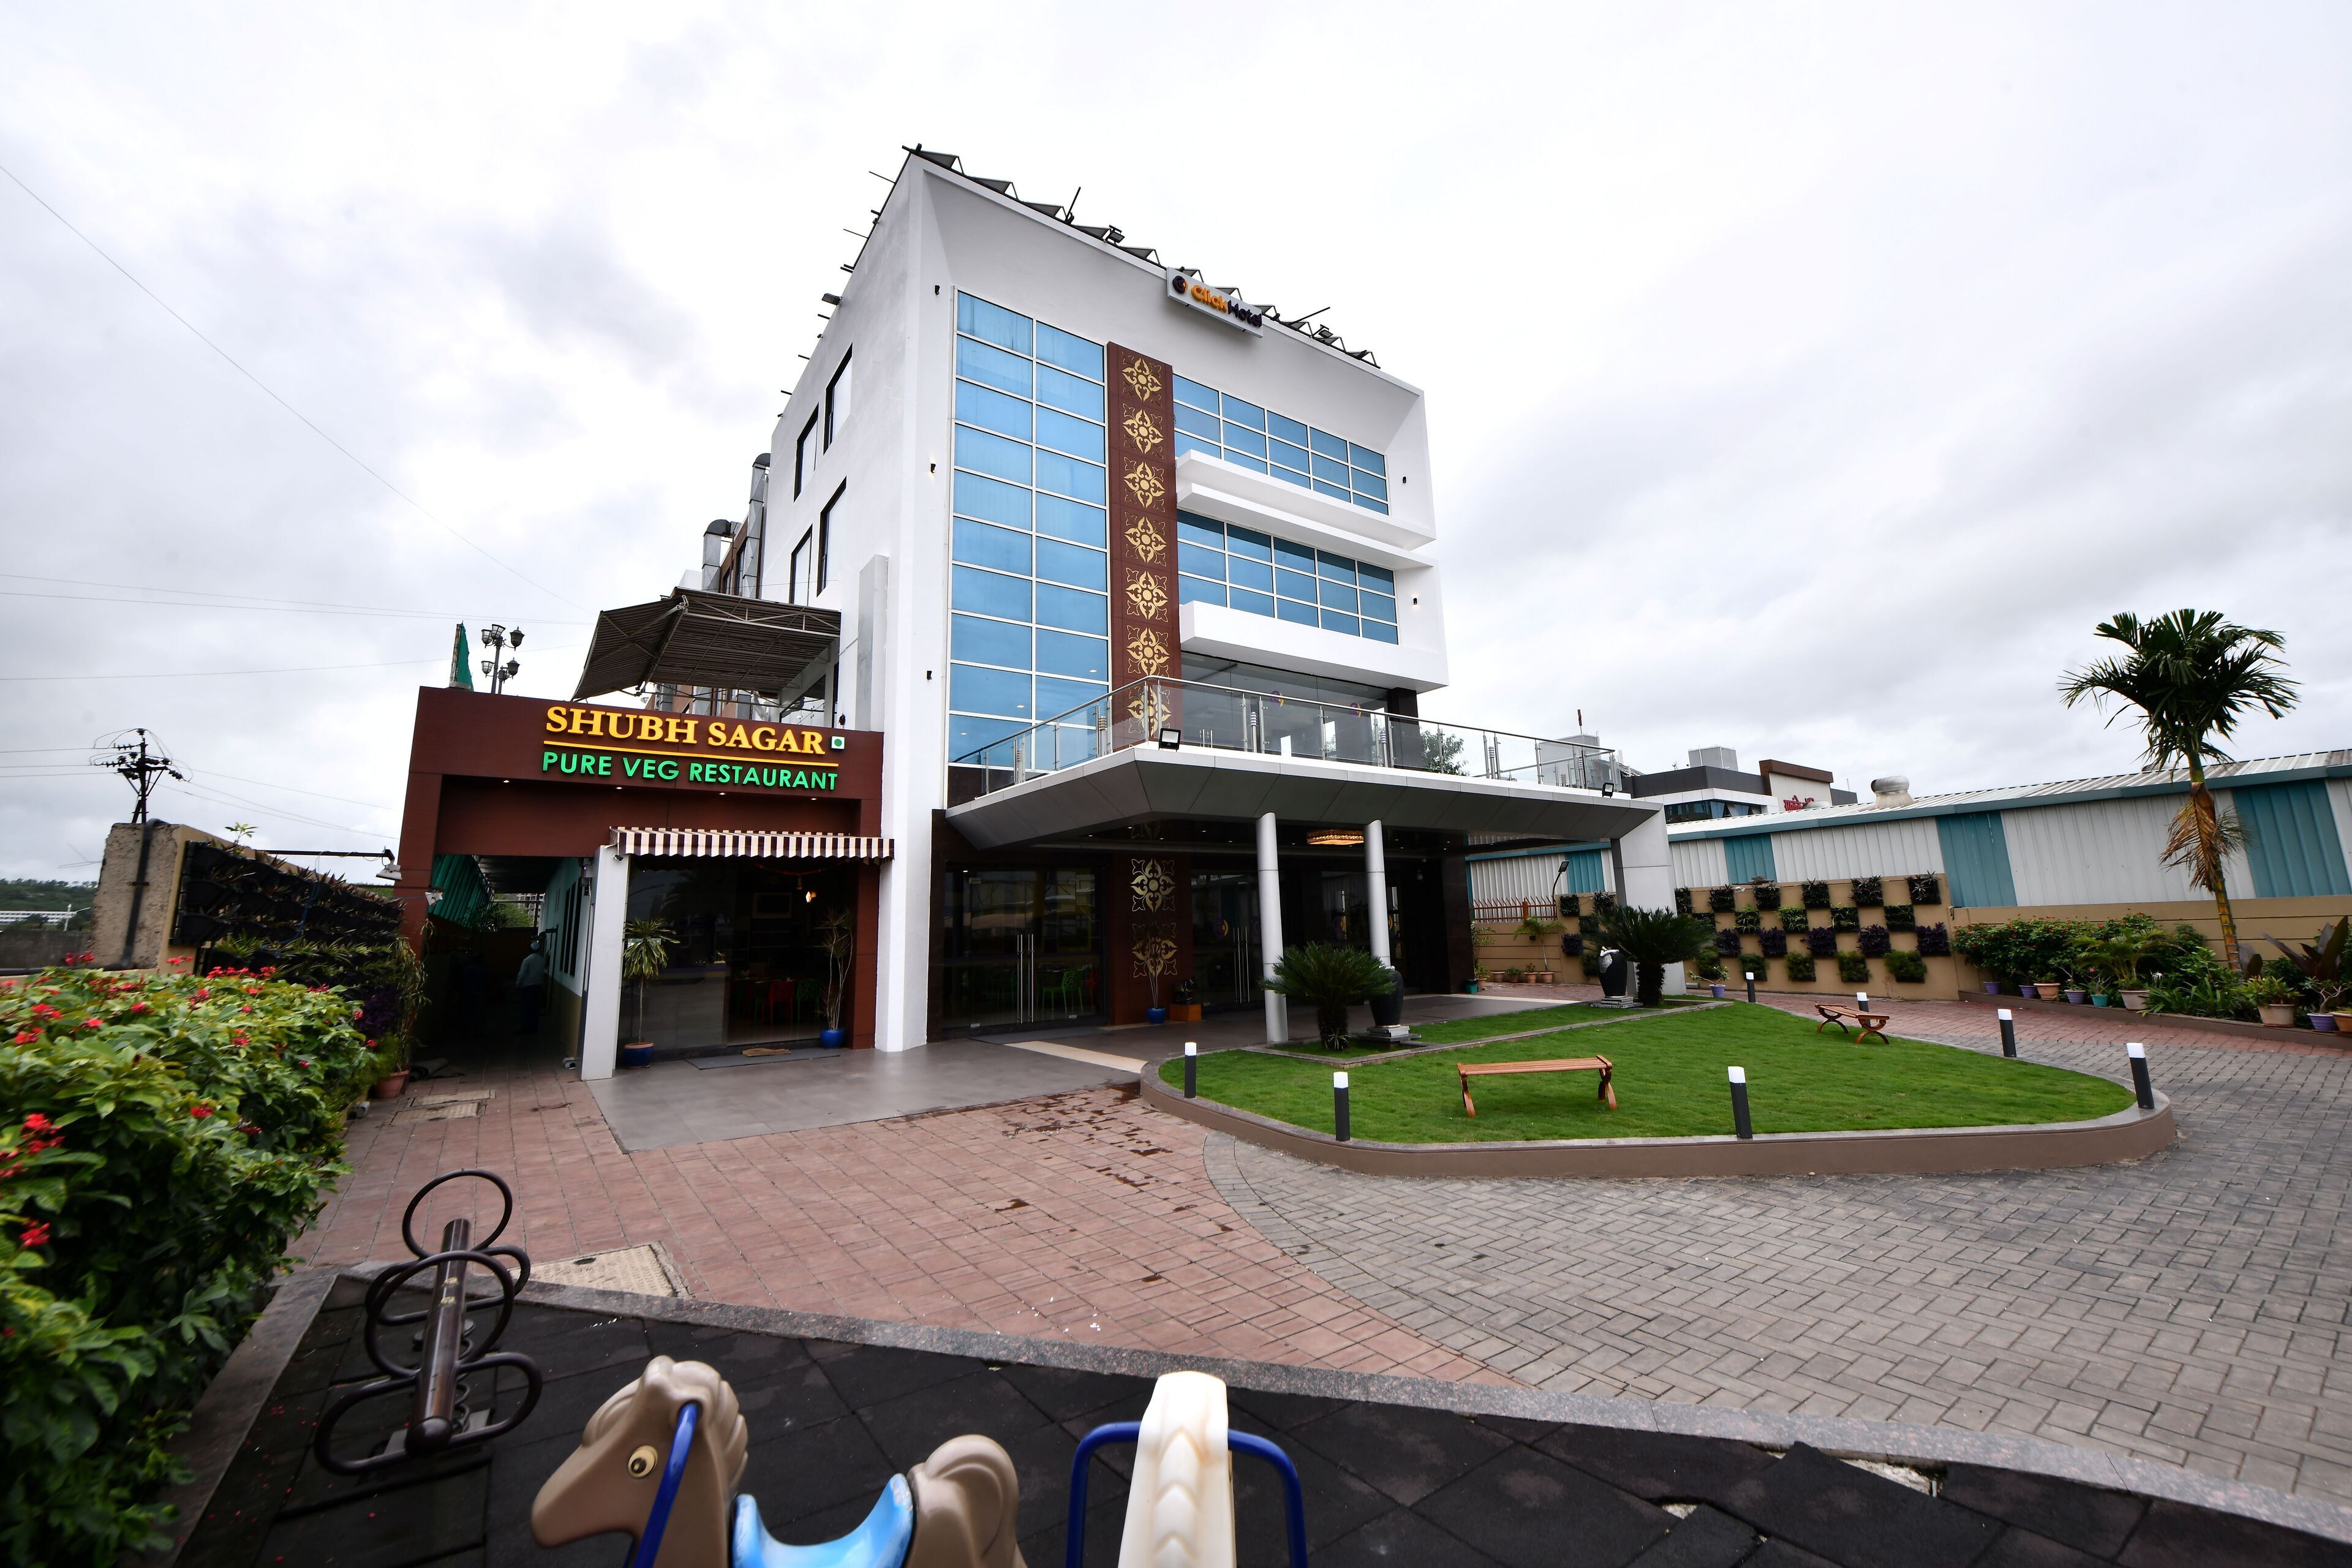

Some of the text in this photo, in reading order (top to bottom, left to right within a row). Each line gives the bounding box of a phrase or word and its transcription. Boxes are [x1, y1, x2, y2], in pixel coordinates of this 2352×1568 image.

[546, 706, 825, 755] SHUBH SAGAR
[543, 752, 838, 790] PURE VEG RESTAURANT
